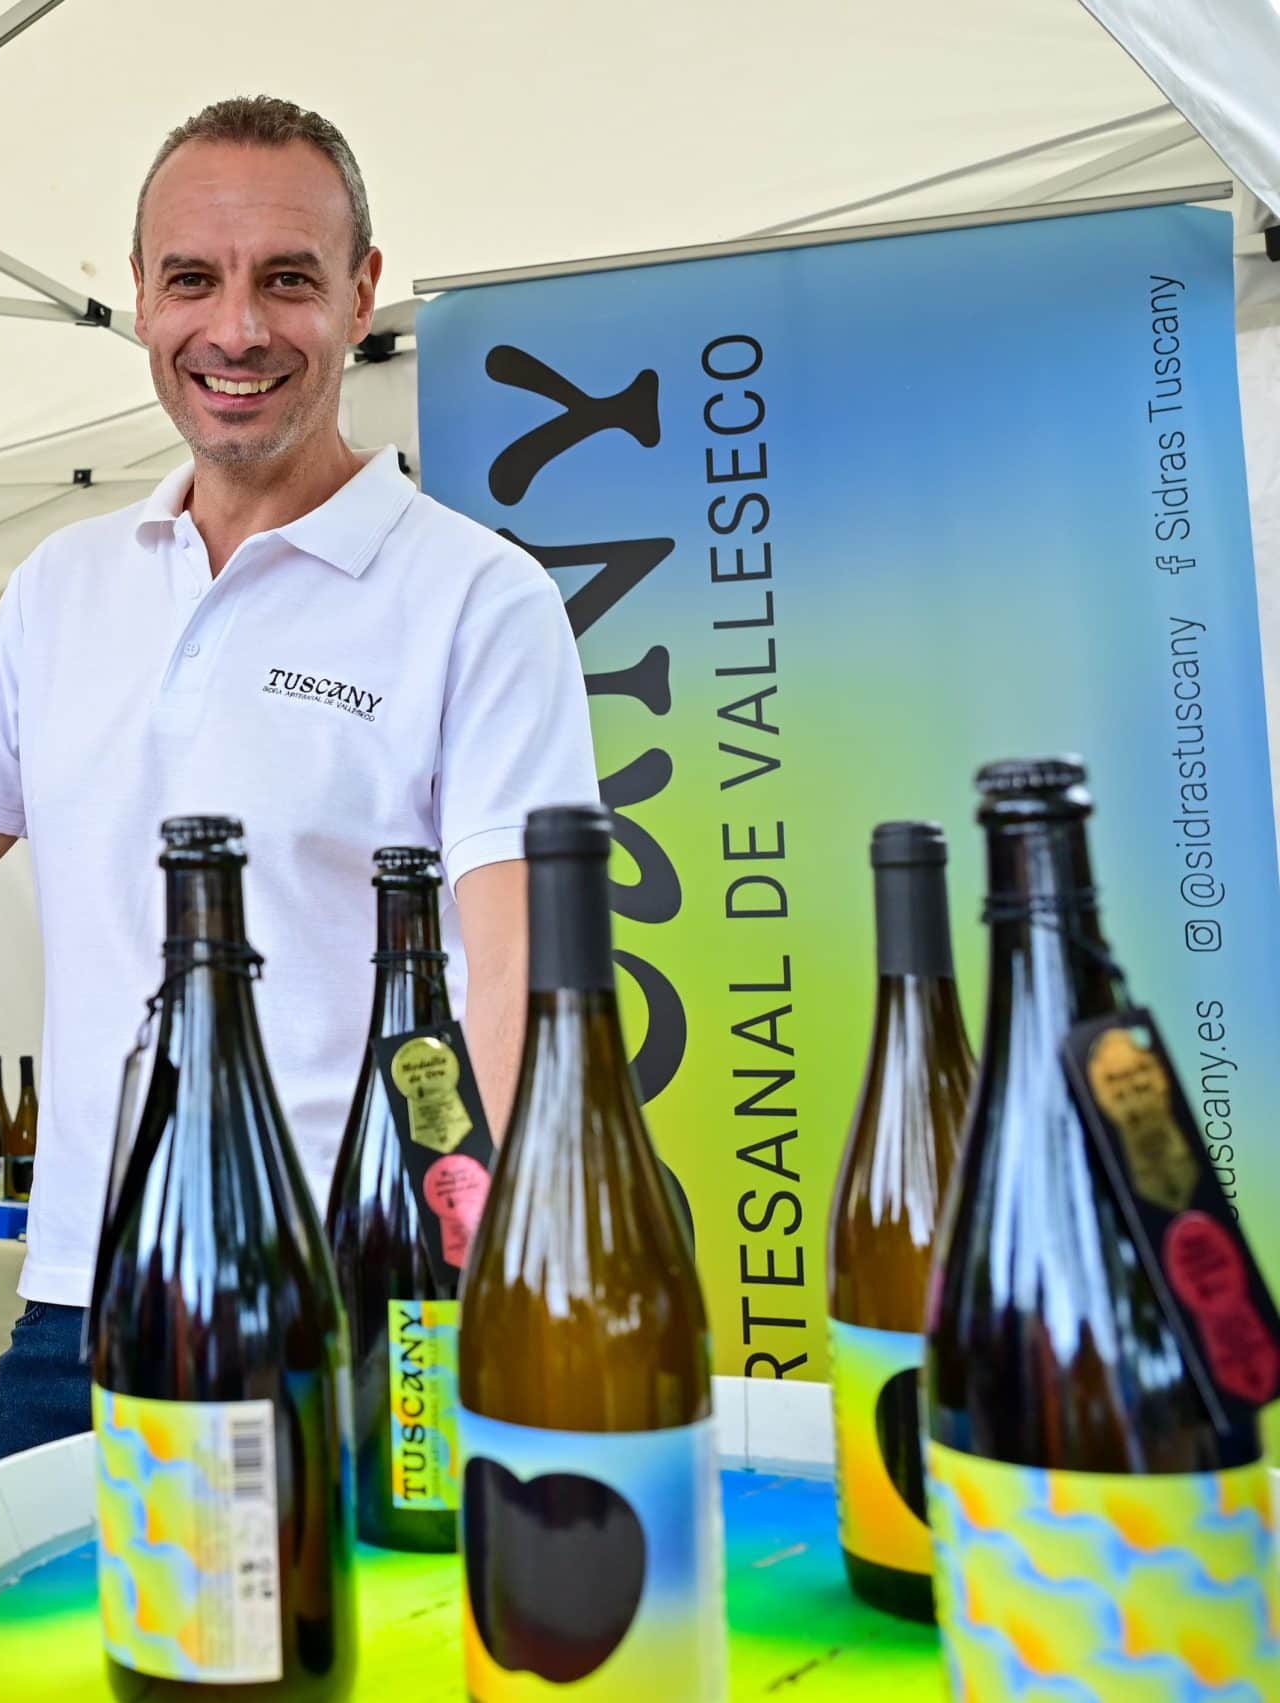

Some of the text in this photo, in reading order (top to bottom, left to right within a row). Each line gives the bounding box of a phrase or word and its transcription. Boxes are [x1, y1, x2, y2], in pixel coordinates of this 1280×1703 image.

[1148, 274, 1190, 540] Sidras Tuscany
[701, 335, 781, 791] VALLESECO
[722, 821, 788, 918] DE
[1169, 617, 1225, 907] @sidrastuscany
